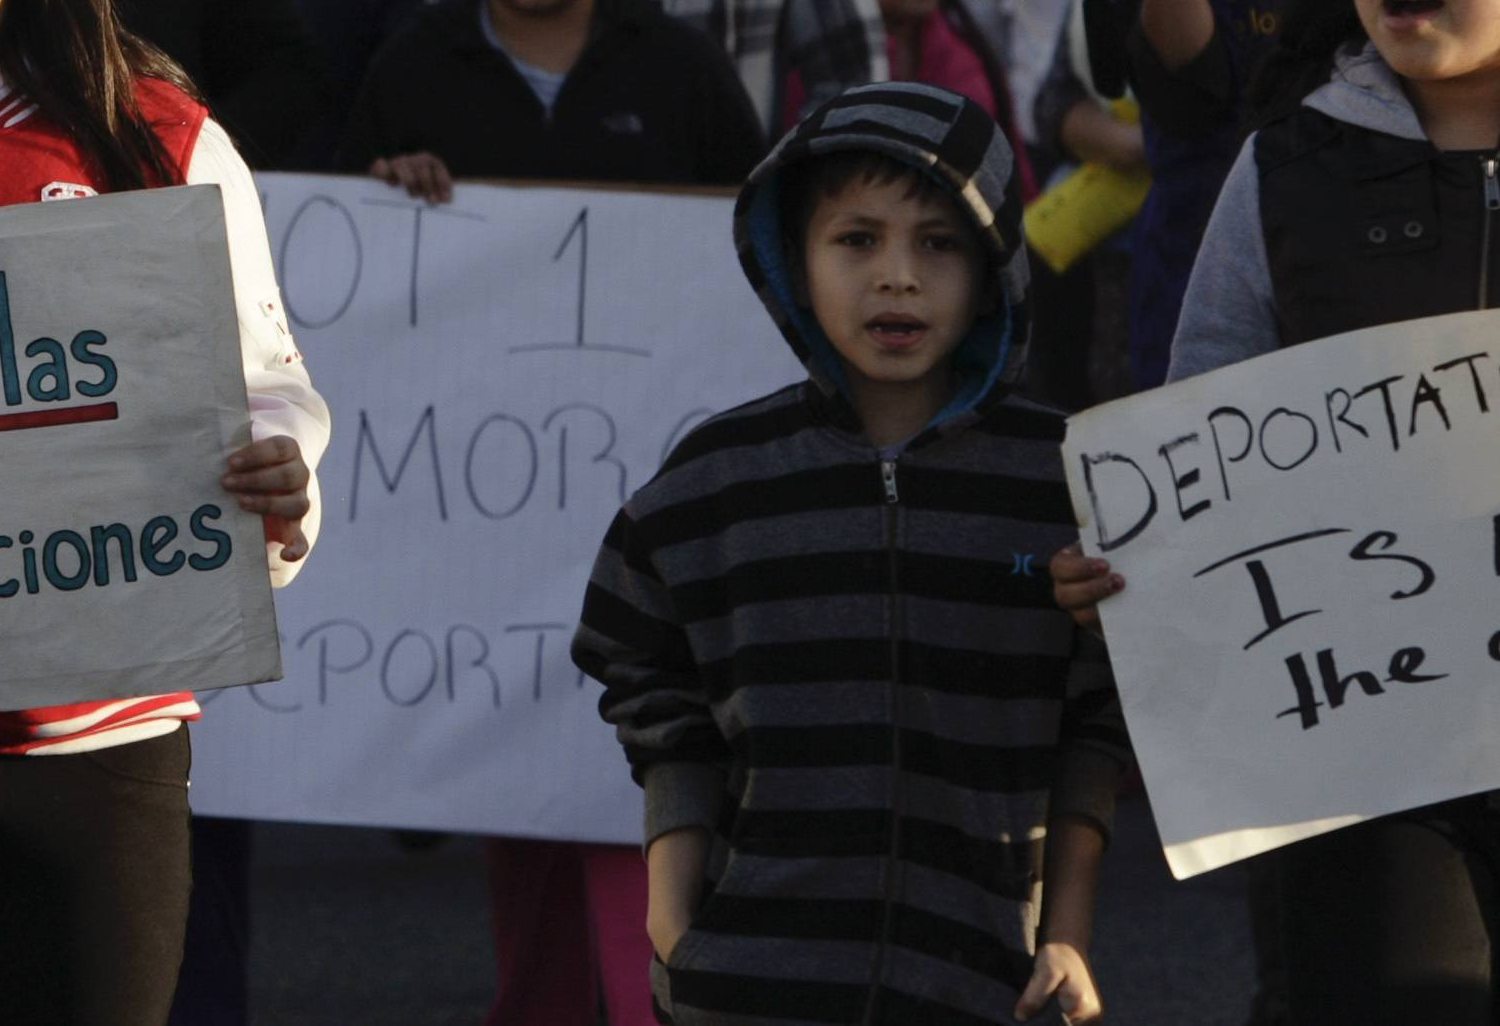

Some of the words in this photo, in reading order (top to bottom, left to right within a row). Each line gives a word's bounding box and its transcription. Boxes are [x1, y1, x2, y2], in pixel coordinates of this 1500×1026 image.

[264, 192, 488, 329] OT
[1080, 350, 1500, 551] DEPORTAT
[1276, 647, 1451, 732] the
